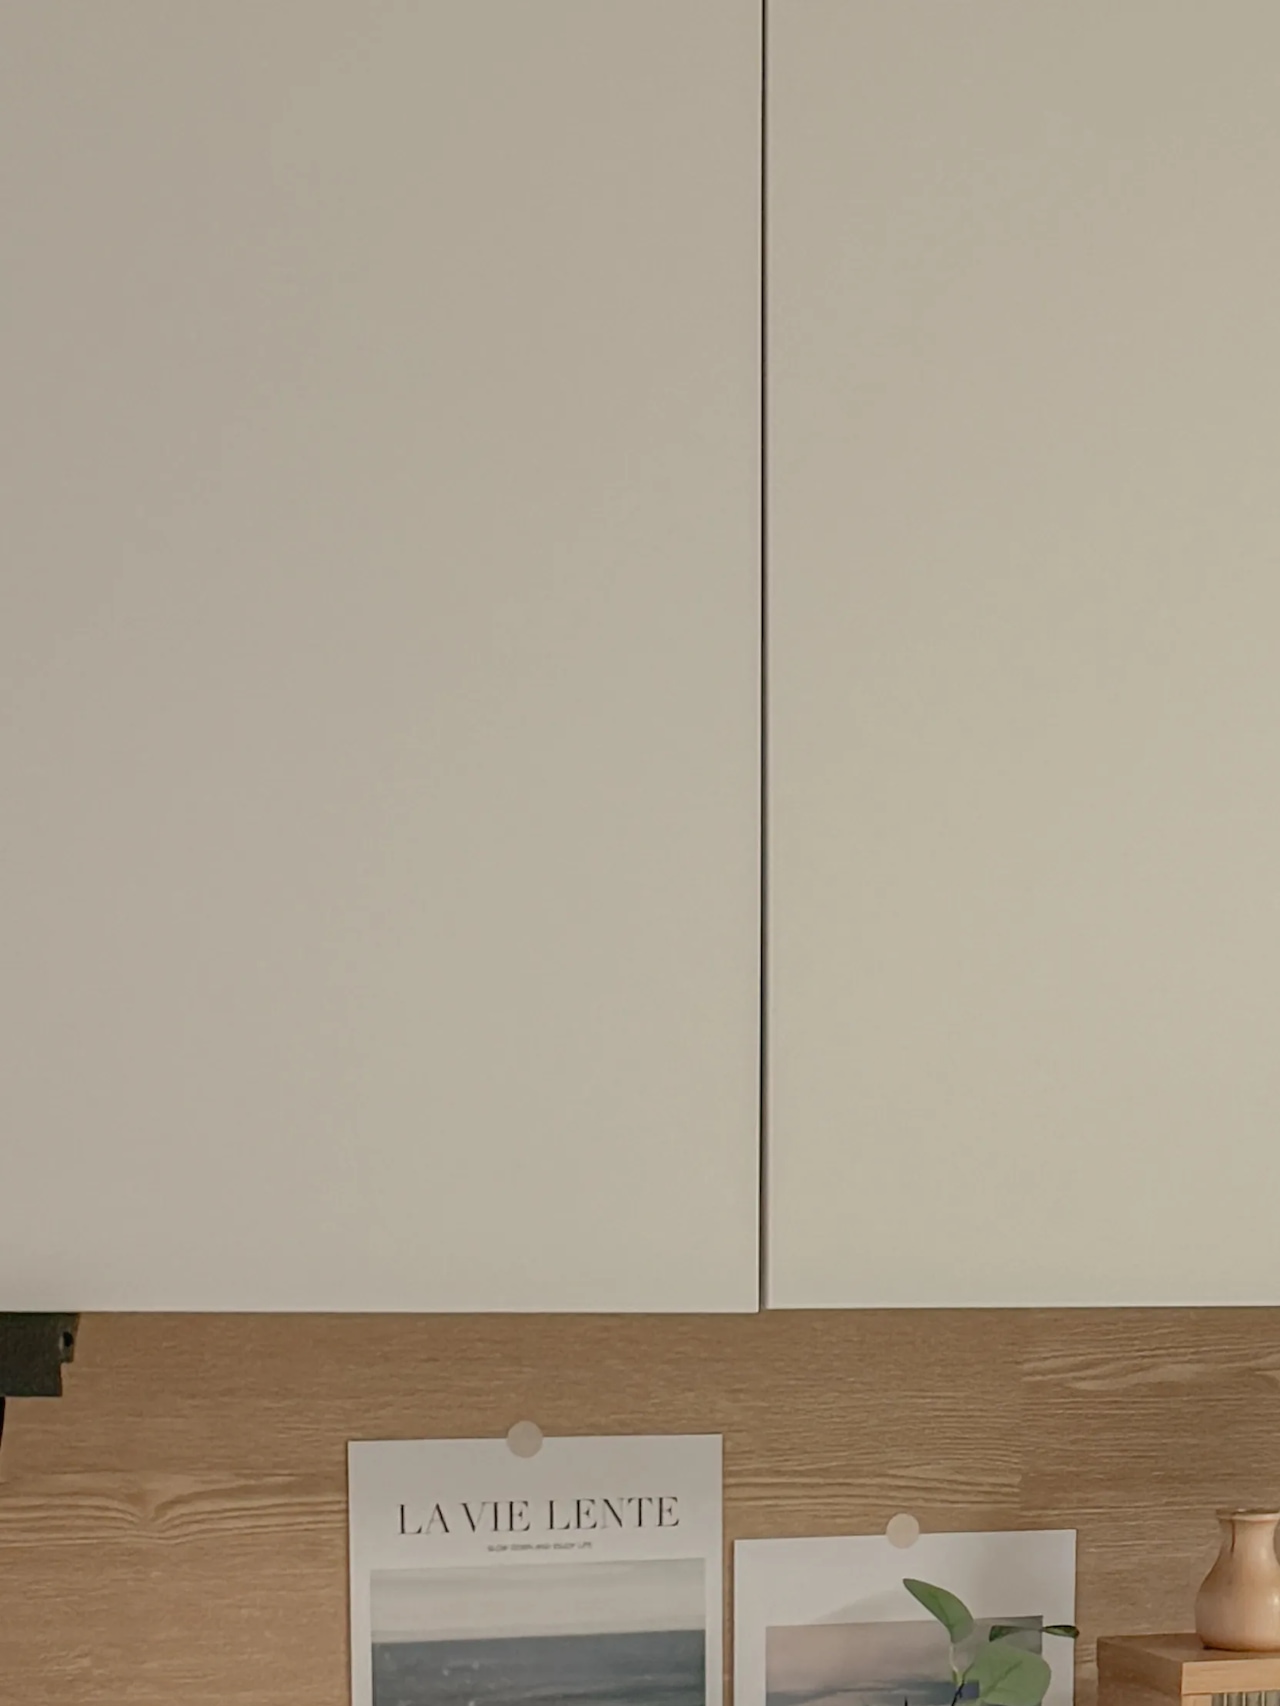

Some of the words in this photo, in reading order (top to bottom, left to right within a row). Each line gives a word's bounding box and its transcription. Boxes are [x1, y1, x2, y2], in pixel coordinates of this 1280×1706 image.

[398, 1503, 450, 1535] LA
[460, 1500, 531, 1533] VIE
[548, 1496, 680, 1530] LENTE
